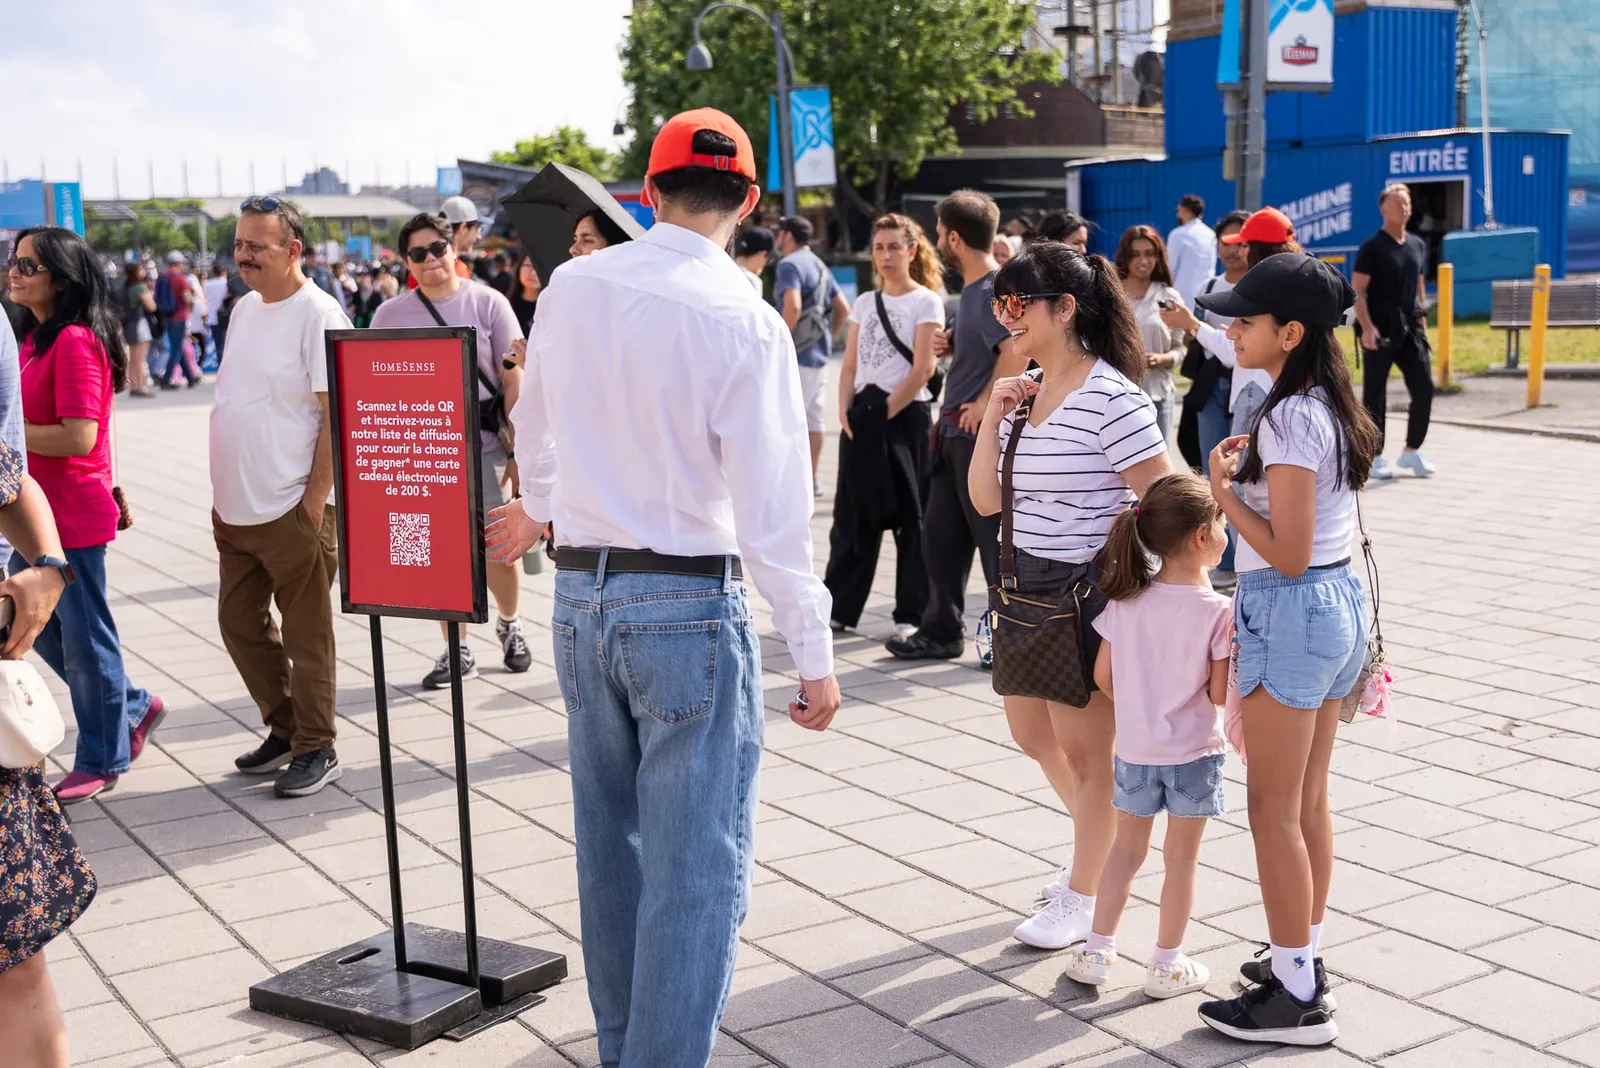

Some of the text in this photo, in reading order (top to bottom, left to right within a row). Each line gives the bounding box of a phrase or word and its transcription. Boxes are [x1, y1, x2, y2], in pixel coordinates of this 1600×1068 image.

[1389, 141, 1469, 174] ENTRÉE
[357, 400, 454, 413] Scannez le code QR
[361, 414, 452, 427] et inscrivez-vous à
[351, 427, 462, 441] notre liste de diffusion
[356, 442, 459, 456] pour courir la chance
[356, 455, 368, 467] de
[413, 460, 432, 468] une
[434, 459, 460, 469] carte
[359, 469, 458, 486] cadeau électronique
[385, 483, 432, 497] de 200 $.
